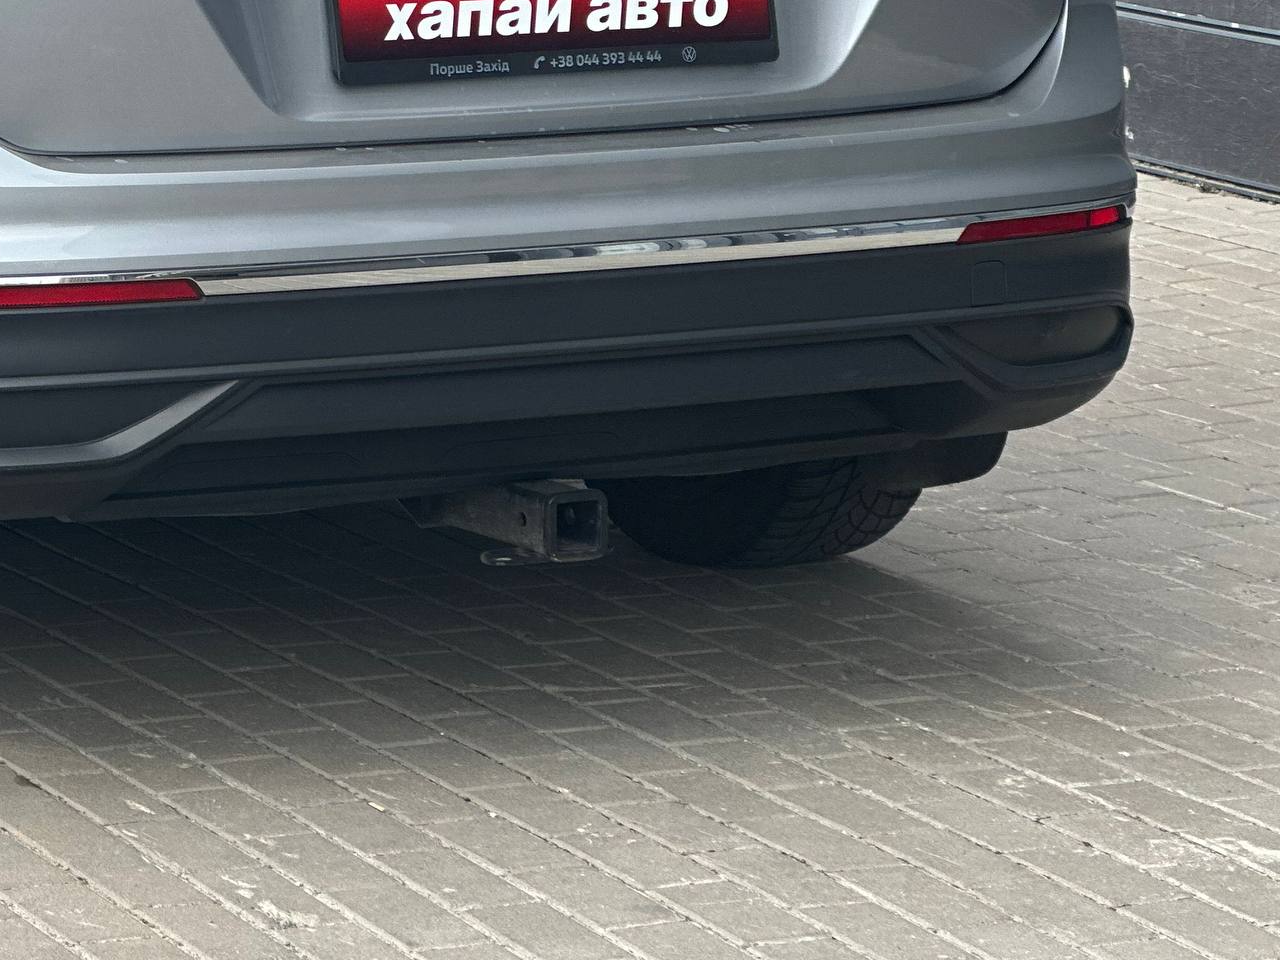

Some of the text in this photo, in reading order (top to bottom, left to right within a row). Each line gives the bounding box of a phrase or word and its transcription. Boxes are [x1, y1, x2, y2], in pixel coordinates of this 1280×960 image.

[429, 62, 474, 77] Порше
[476, 58, 510, 74] Захід
[550, 54, 574, 68] +38
[576, 53, 600, 66] 044
[602, 51, 625, 65] 393
[628, 50, 645, 64] 44
[646, 49, 662, 62] 44
